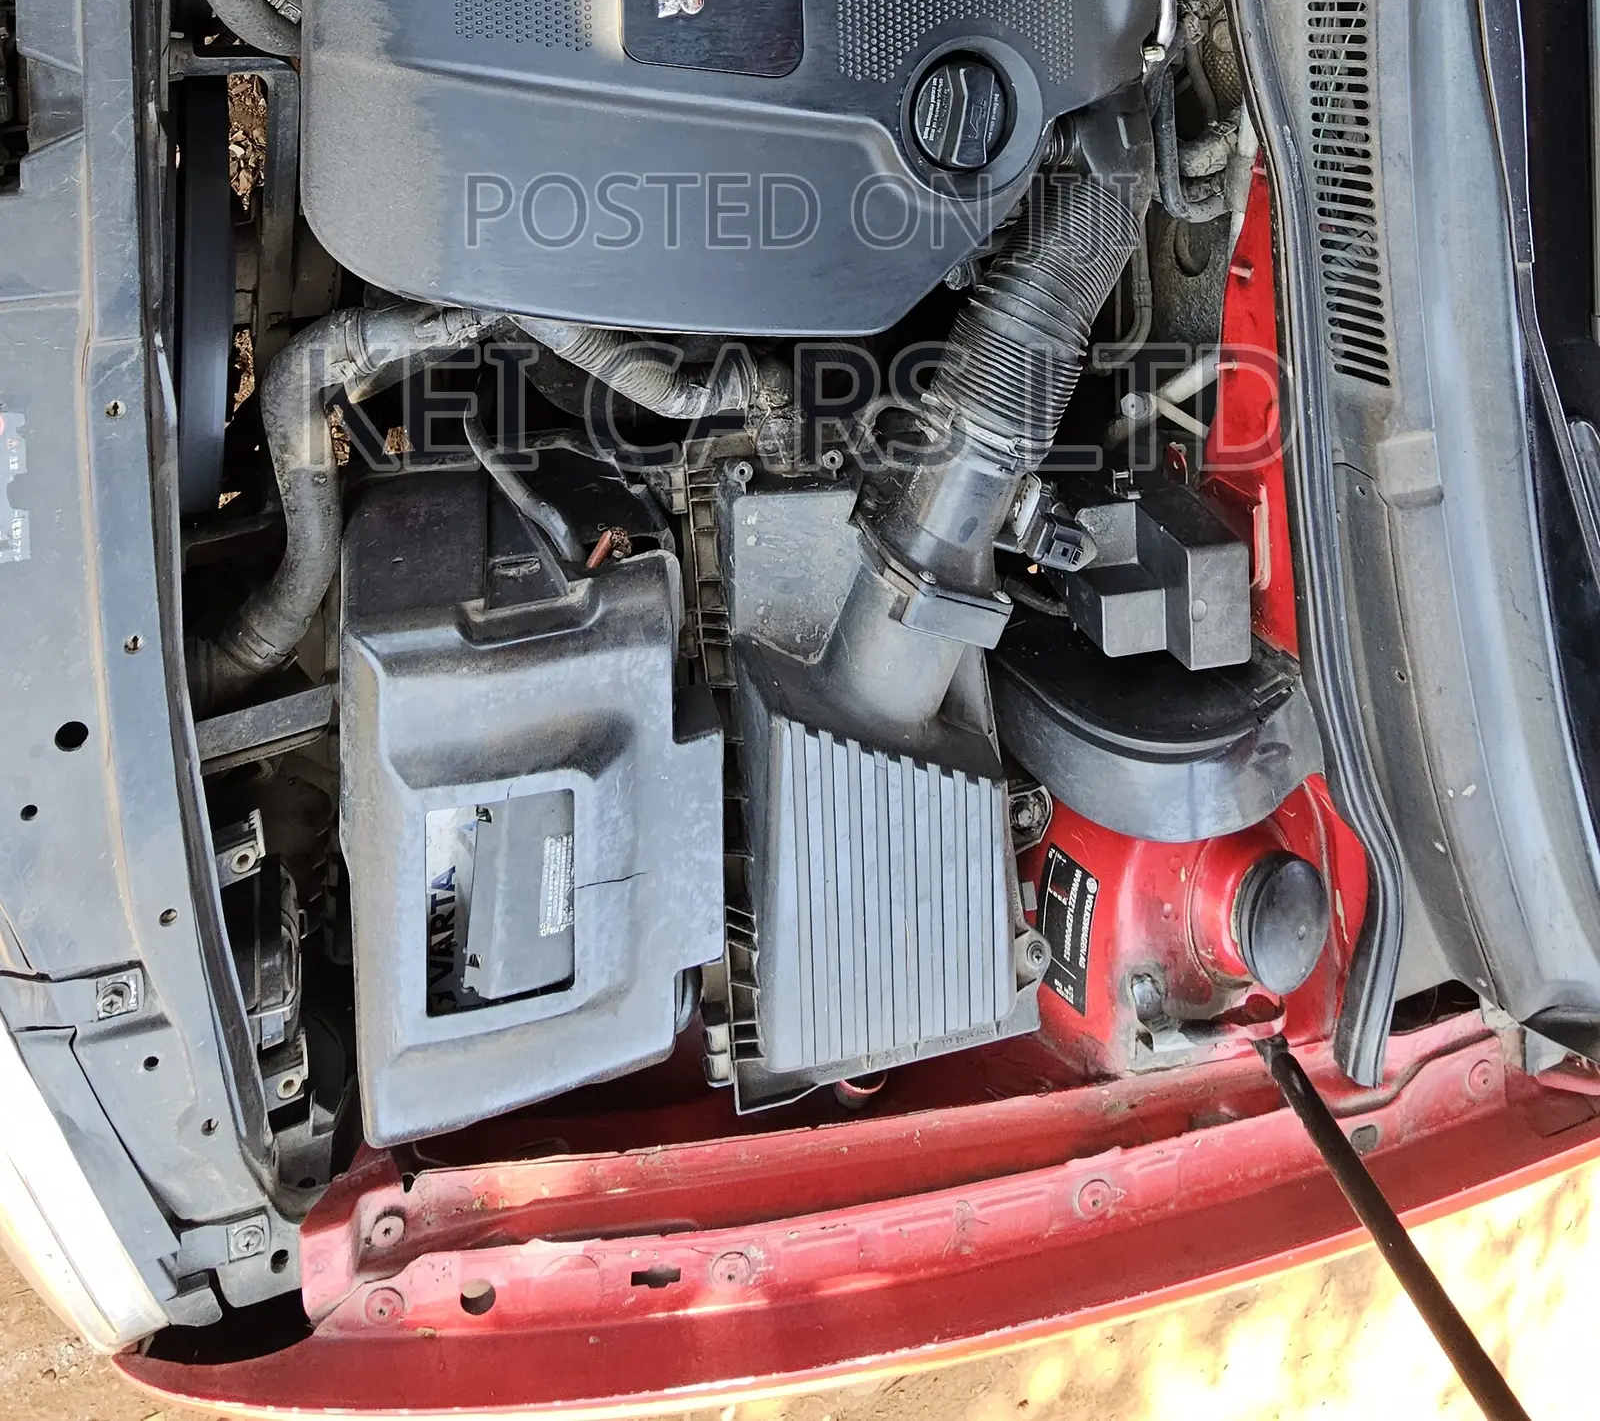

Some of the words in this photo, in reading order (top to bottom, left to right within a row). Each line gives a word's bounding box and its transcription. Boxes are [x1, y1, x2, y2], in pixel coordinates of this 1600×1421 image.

[430, 865, 457, 987] VARTA
[1079, 894, 1094, 954] VOLKSWAGEN
[1078, 954, 1087, 969] AG
